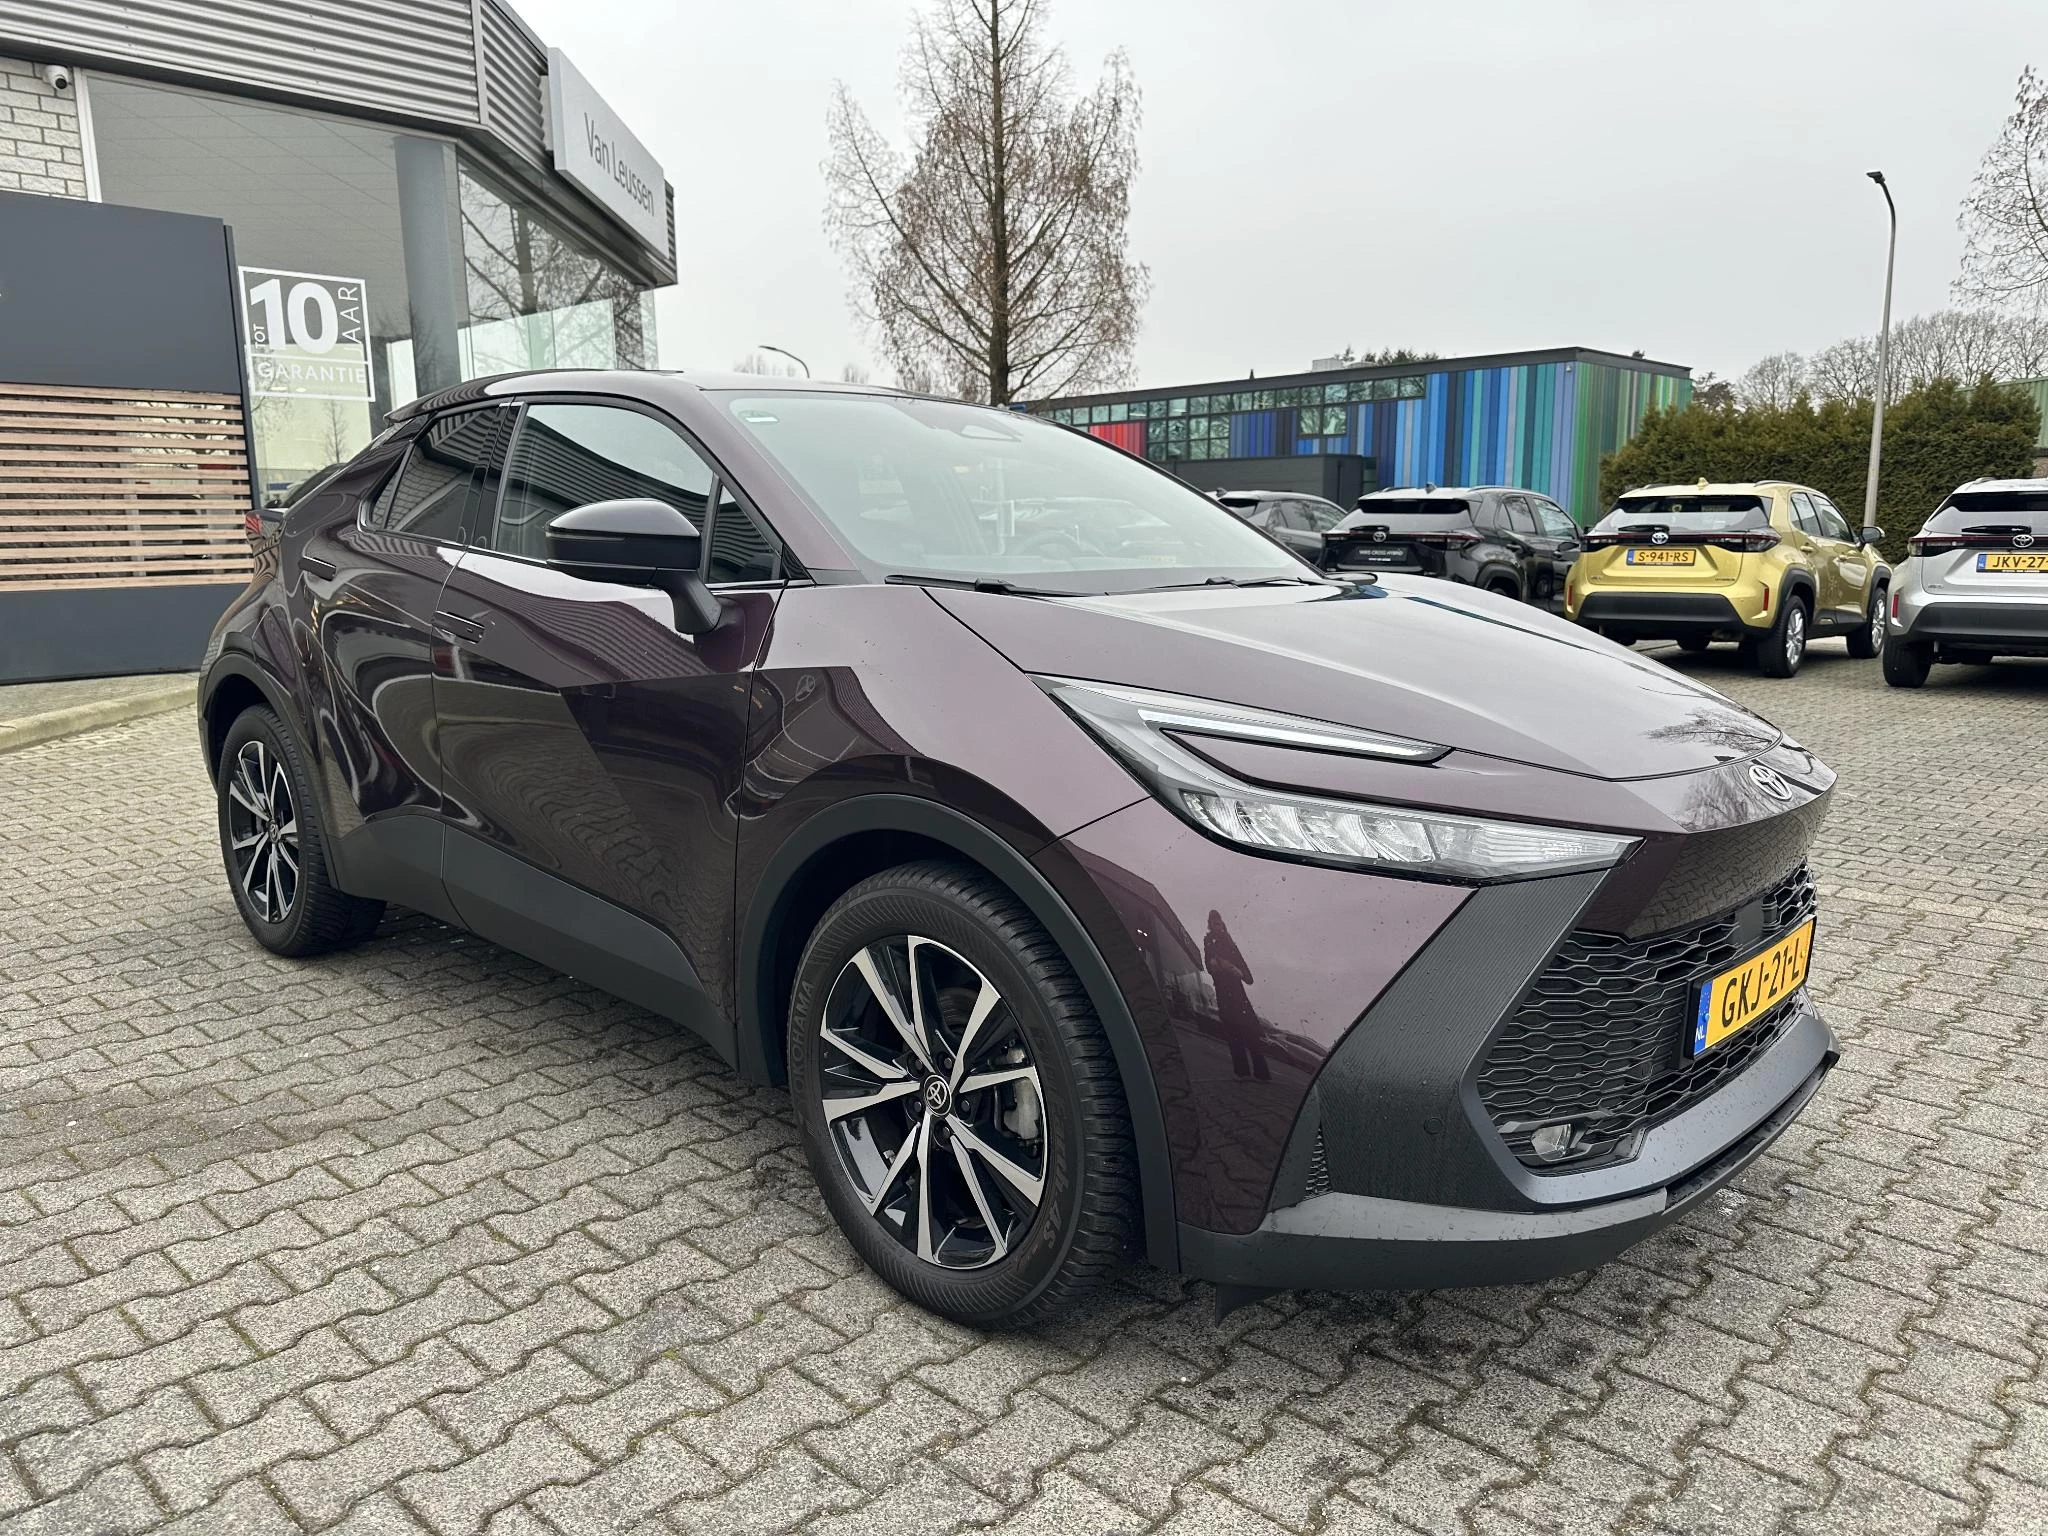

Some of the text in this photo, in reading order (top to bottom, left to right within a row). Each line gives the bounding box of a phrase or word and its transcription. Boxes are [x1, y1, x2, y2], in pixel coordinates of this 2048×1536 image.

[584, 112, 655, 217] Van Leussen
[249, 278, 339, 355] 10
[253, 323, 266, 349] TOT
[257, 361, 367, 384] GARANTIE
[1638, 551, 1689, 562] S-941-RS
[1721, 937, 1800, 1029] GKJ-21-L
[1695, 1025, 1706, 1042] NL
